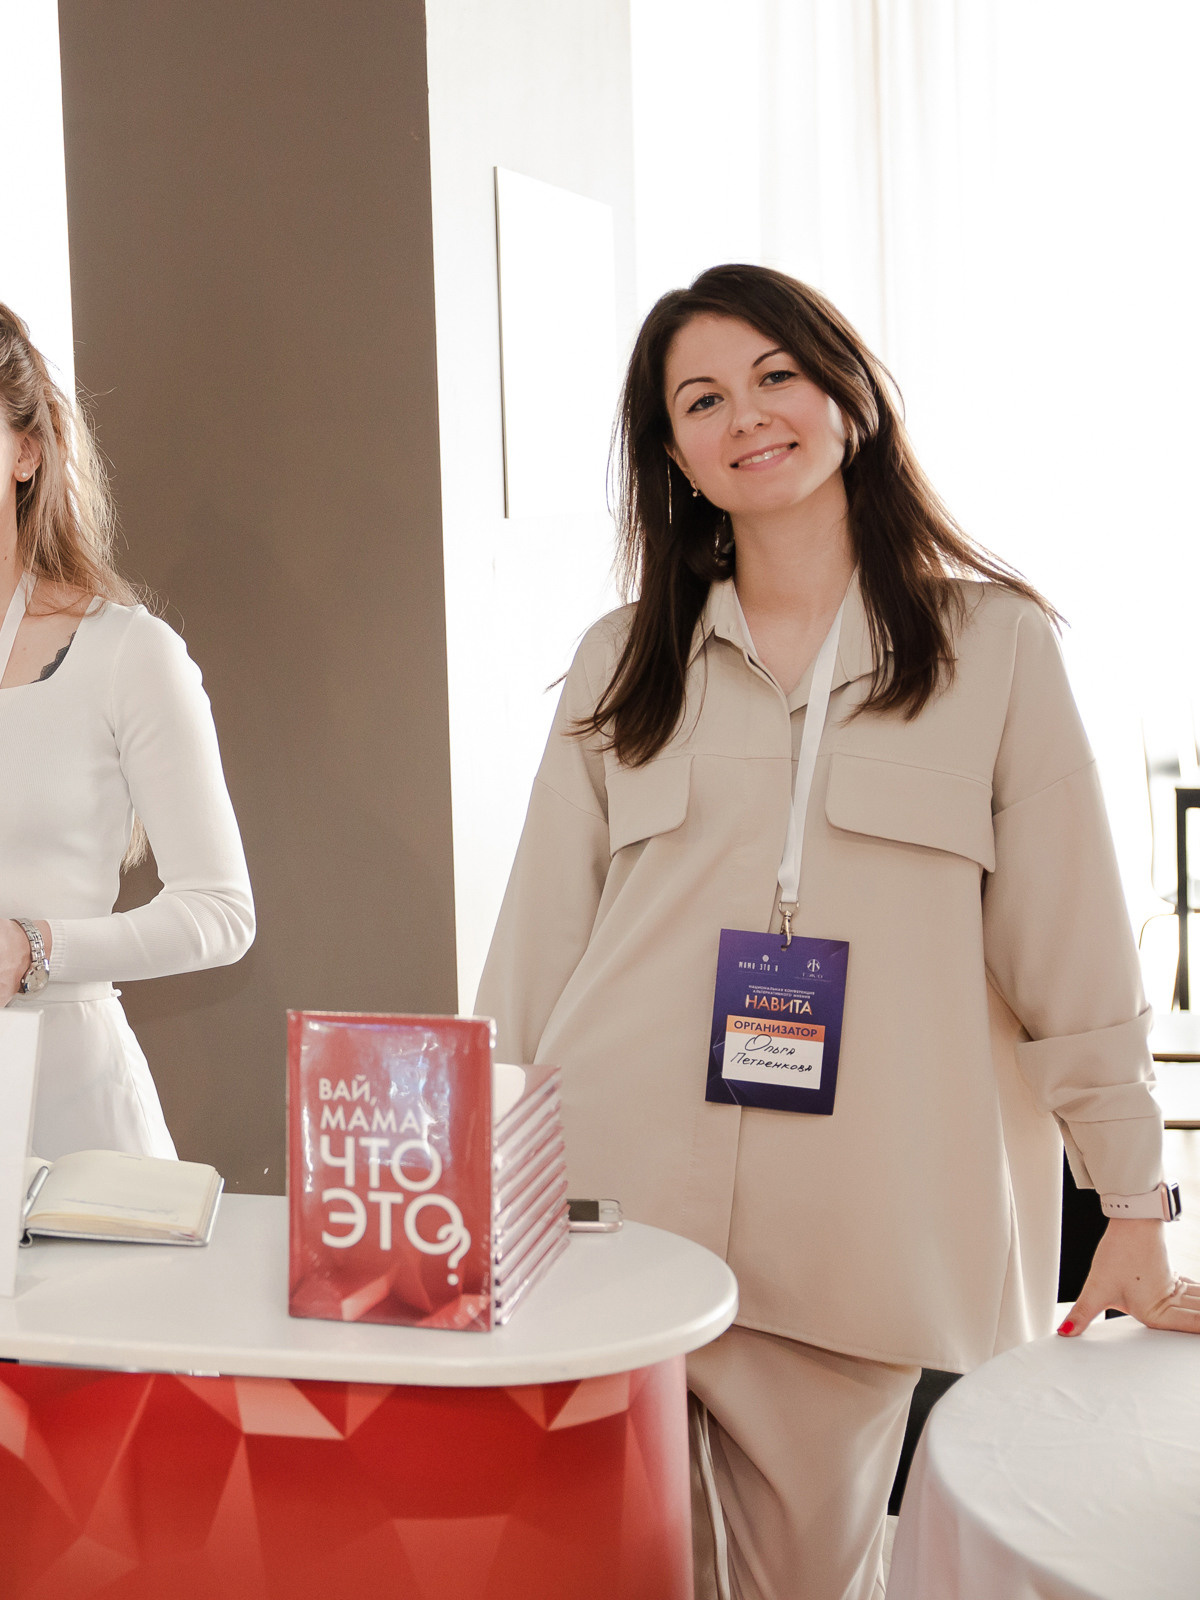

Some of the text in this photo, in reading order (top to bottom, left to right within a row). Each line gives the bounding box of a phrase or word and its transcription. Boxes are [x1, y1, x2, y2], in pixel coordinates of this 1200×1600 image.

[745, 994, 813, 1016] НАВИТА
[734, 1020, 818, 1038] ОРГАНИЗАТОР
[744, 1034, 796, 1056] Ольга
[318, 1074, 378, 1107] ВАЙ,
[319, 1134, 443, 1193] ЧТО
[321, 1187, 472, 1286] ЭТО?
